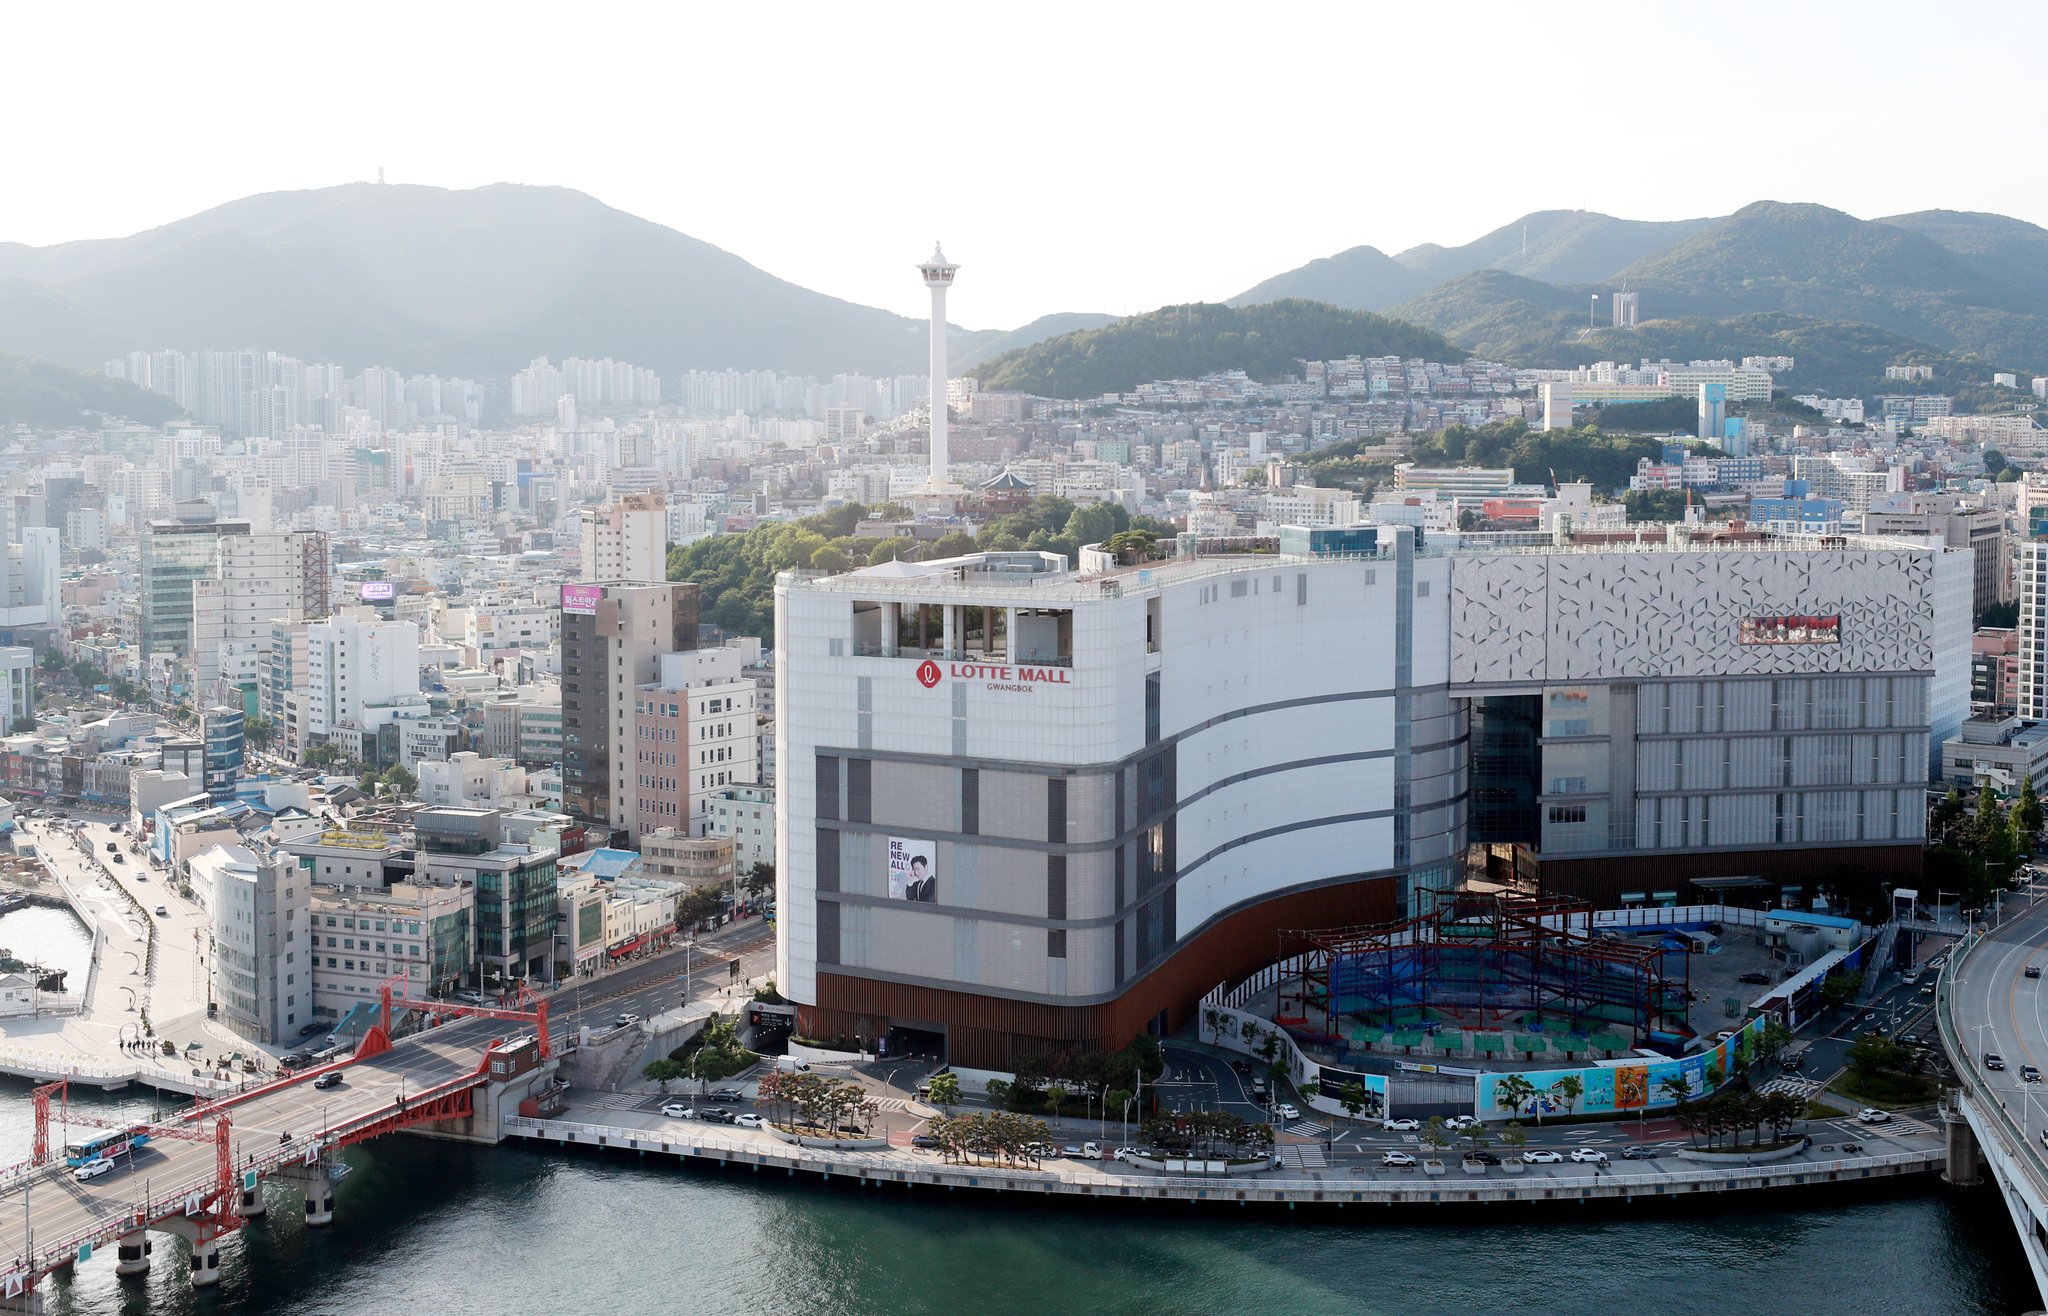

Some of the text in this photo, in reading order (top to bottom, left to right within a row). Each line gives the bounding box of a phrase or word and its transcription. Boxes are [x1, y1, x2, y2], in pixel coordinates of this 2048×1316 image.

[951, 664, 1071, 684] LOTTE MALL
[987, 683, 1033, 693] GWANGBOK
[890, 841, 903, 850] RE
[890, 851, 910, 862] NEW
[890, 860, 905, 871] ALL
